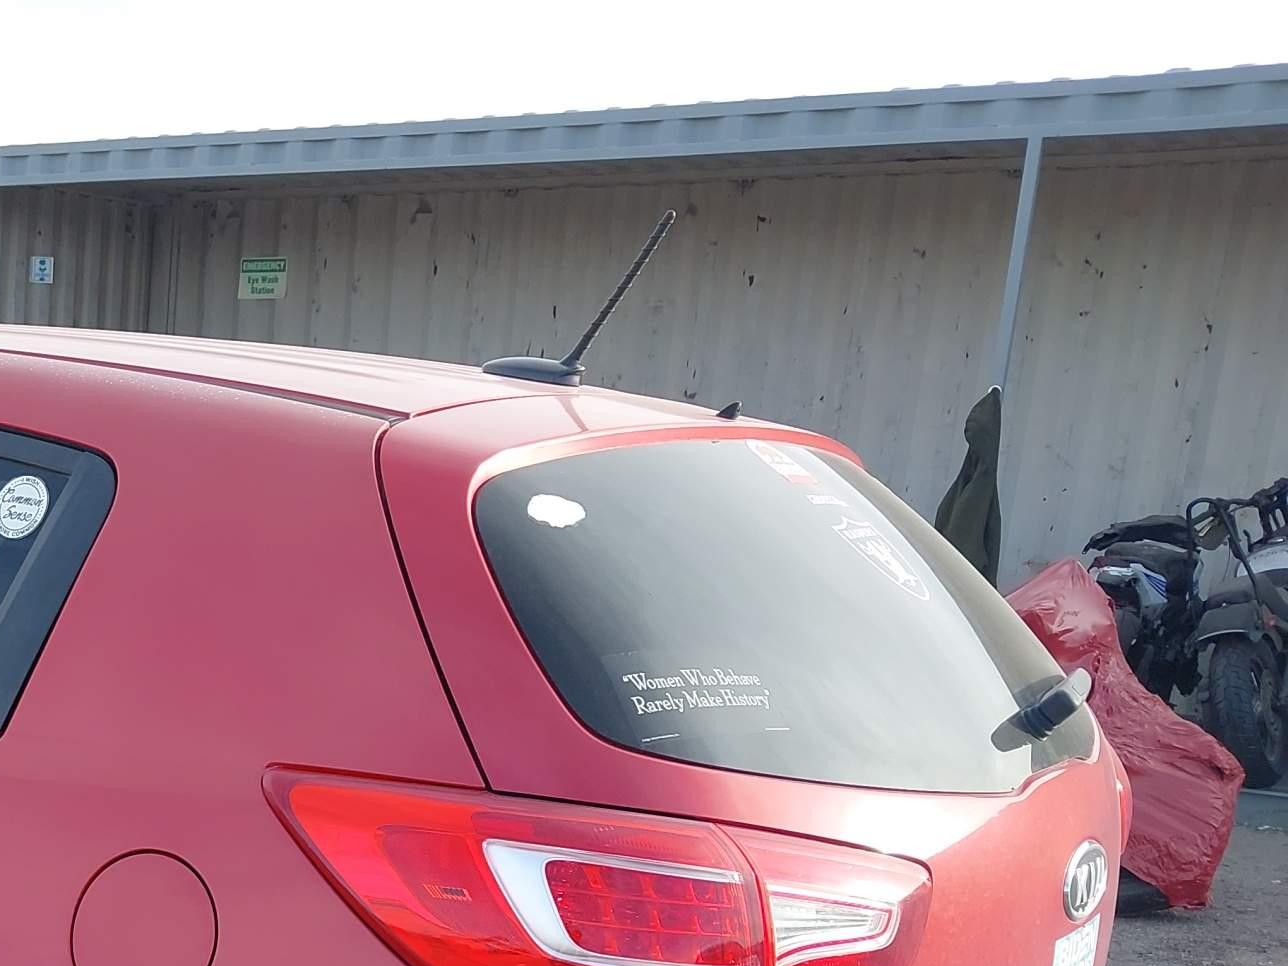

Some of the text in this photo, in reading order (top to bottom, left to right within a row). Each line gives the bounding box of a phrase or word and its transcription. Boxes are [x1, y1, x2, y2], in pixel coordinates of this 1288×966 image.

[261, 275, 279, 284] Wash
[251, 287, 275, 295] Station
[2, 487, 43, 507] Common
[2, 504, 33, 522] Sense
[680, 669, 717, 686] Who
[713, 669, 762, 686] Behave
[630, 693, 684, 714] Rarely
[682, 690, 724, 709] Make
[1074, 855, 1106, 907] KIA
